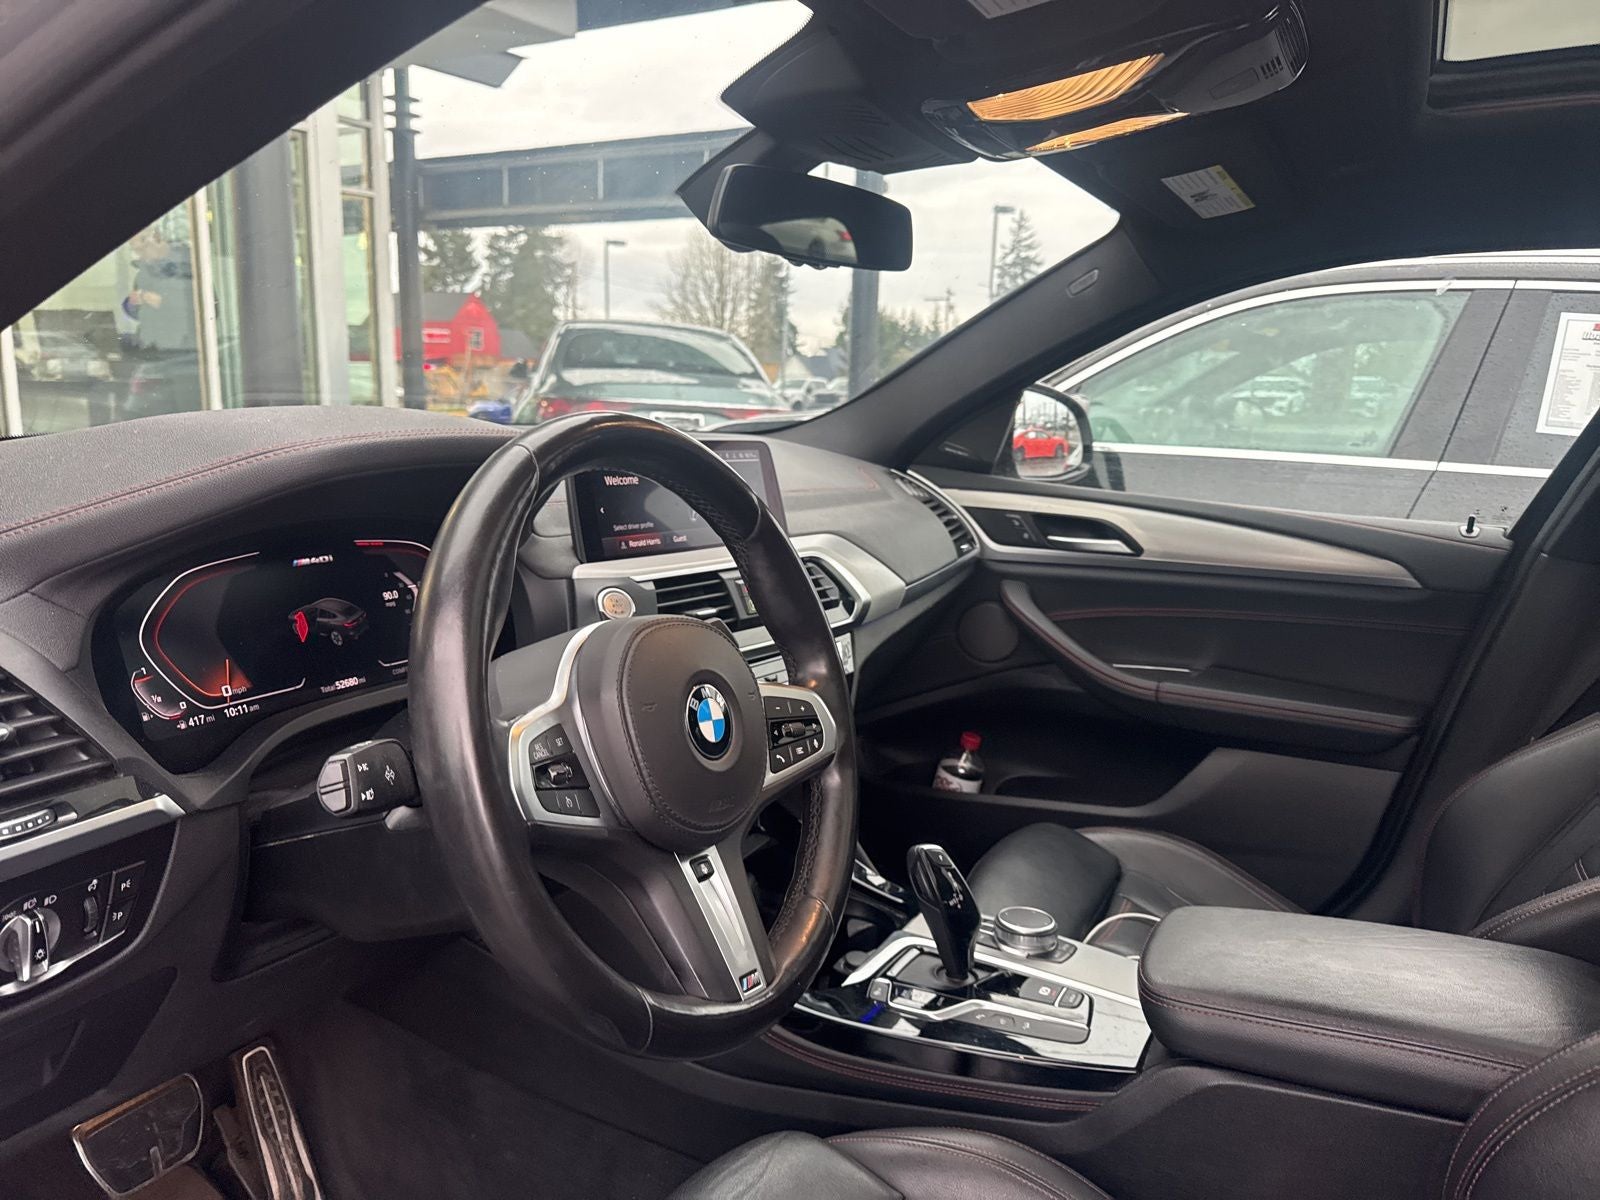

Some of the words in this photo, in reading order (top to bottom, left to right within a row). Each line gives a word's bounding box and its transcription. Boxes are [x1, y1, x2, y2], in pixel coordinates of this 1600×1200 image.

[604, 476, 639, 486] Welcome
[613, 523, 627, 531] Select
[673, 535, 687, 543] Guest
[382, 590, 399, 601] 90.0
[221, 685, 232, 697] 0
[232, 686, 247, 695] mph
[320, 685, 336, 693] Total
[335, 677, 359, 690] 52680
[690, 687, 726, 712] BMW
[224, 704, 249, 718] 10:11
[249, 703, 260, 712] am
[188, 714, 205, 728] 417
[206, 714, 215, 723] mi
